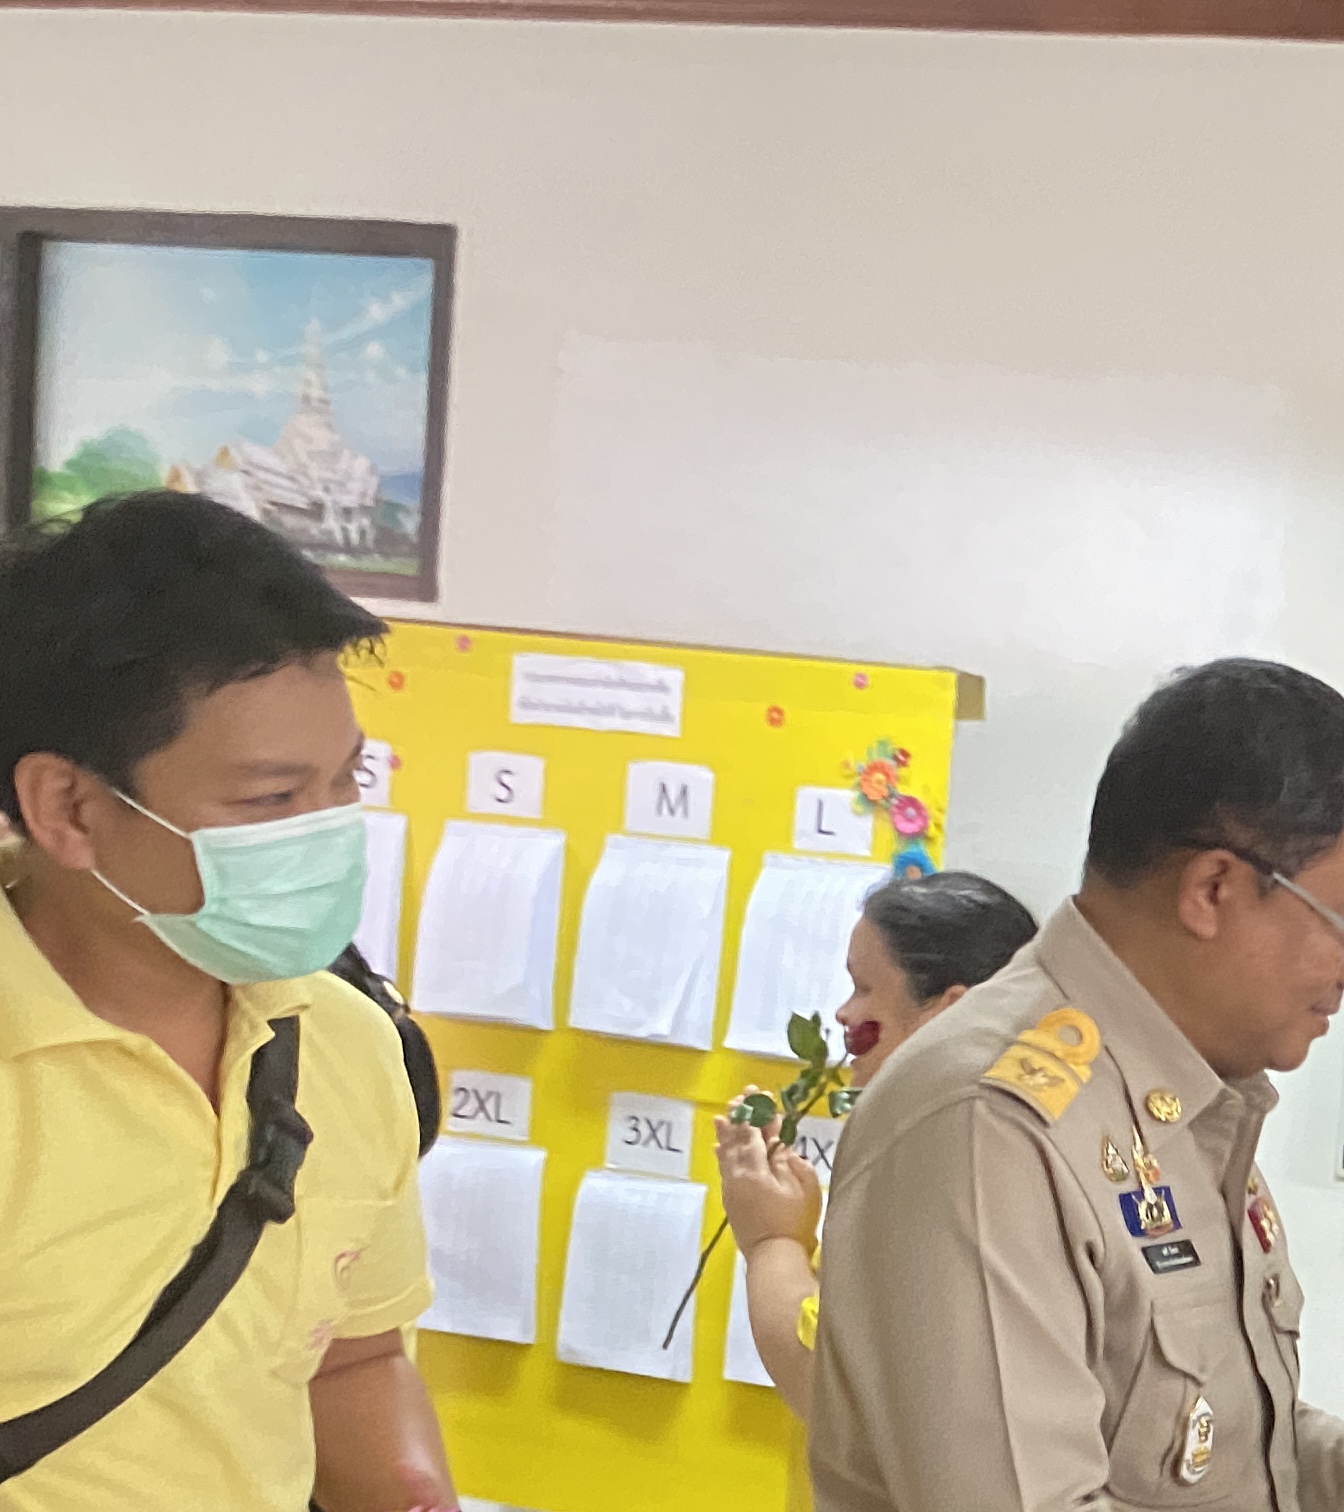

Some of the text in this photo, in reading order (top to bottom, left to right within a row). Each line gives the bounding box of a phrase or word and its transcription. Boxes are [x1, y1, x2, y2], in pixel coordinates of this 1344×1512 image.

[494, 768, 514, 804] S
[656, 782, 690, 818] M
[815, 800, 837, 837] L
[451, 1087, 511, 1125] 2XL
[623, 1115, 682, 1154] 3XL
